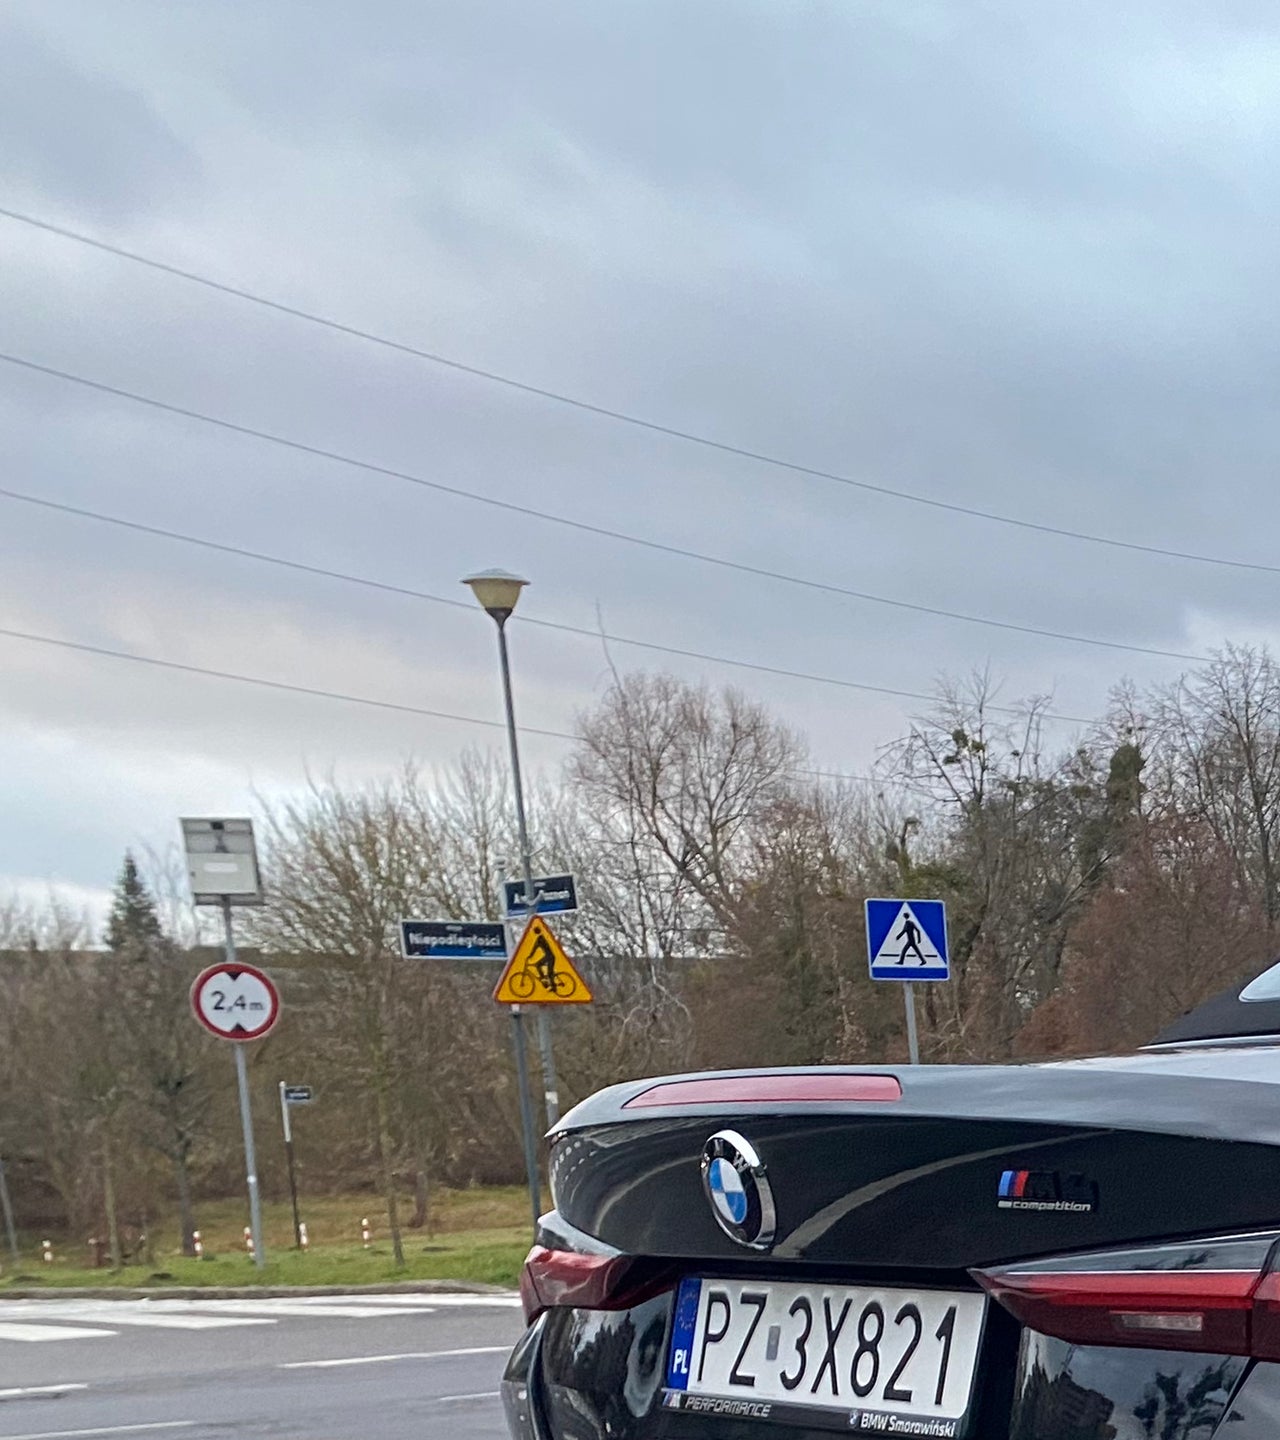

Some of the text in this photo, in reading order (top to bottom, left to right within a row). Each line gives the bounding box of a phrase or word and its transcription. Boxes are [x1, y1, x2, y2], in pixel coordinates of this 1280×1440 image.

[1013, 1201, 1092, 1212] competition
[672, 1348, 688, 1374] PL
[697, 1291, 957, 1406] PZ 3X821
[684, 1396, 773, 1418] PERFORMANCE
[860, 1412, 956, 1437] BMW Smorawiński
